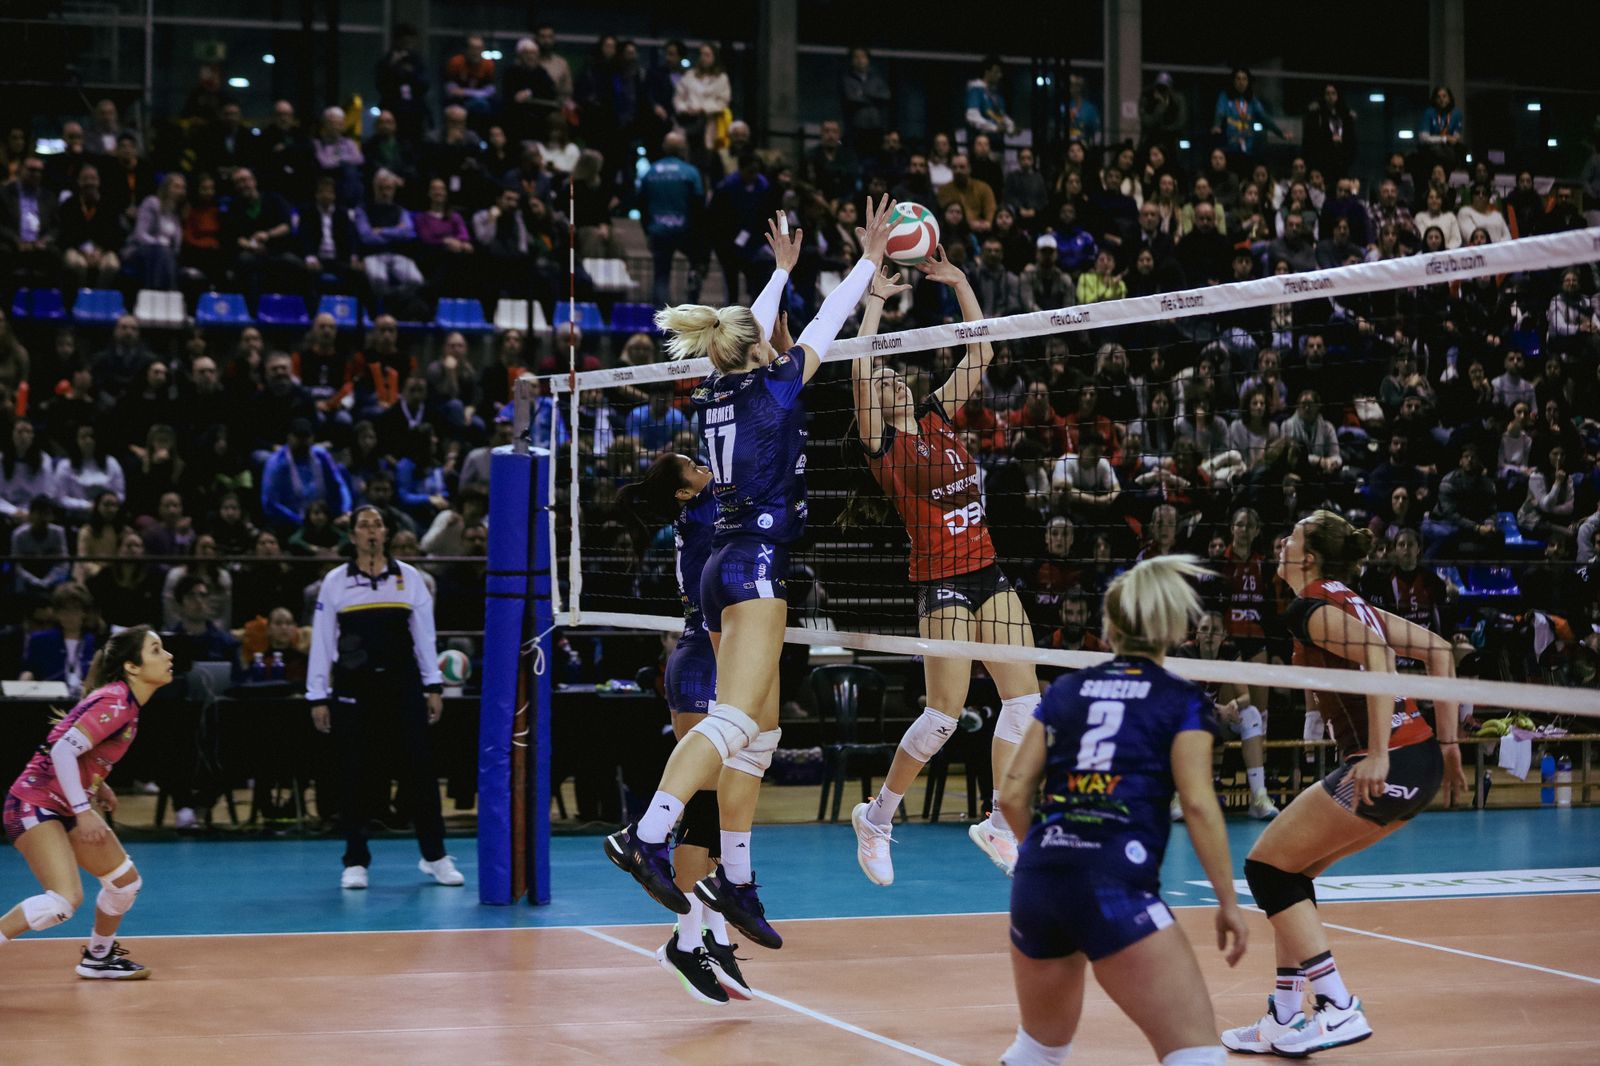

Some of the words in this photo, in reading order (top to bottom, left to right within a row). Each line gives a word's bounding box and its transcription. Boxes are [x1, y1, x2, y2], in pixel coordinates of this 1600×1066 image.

[706, 404, 735, 425] ARMER
[705, 423, 737, 484] 17
[1079, 679, 1152, 699] SAUCEDO
[1075, 700, 1126, 771] 2
